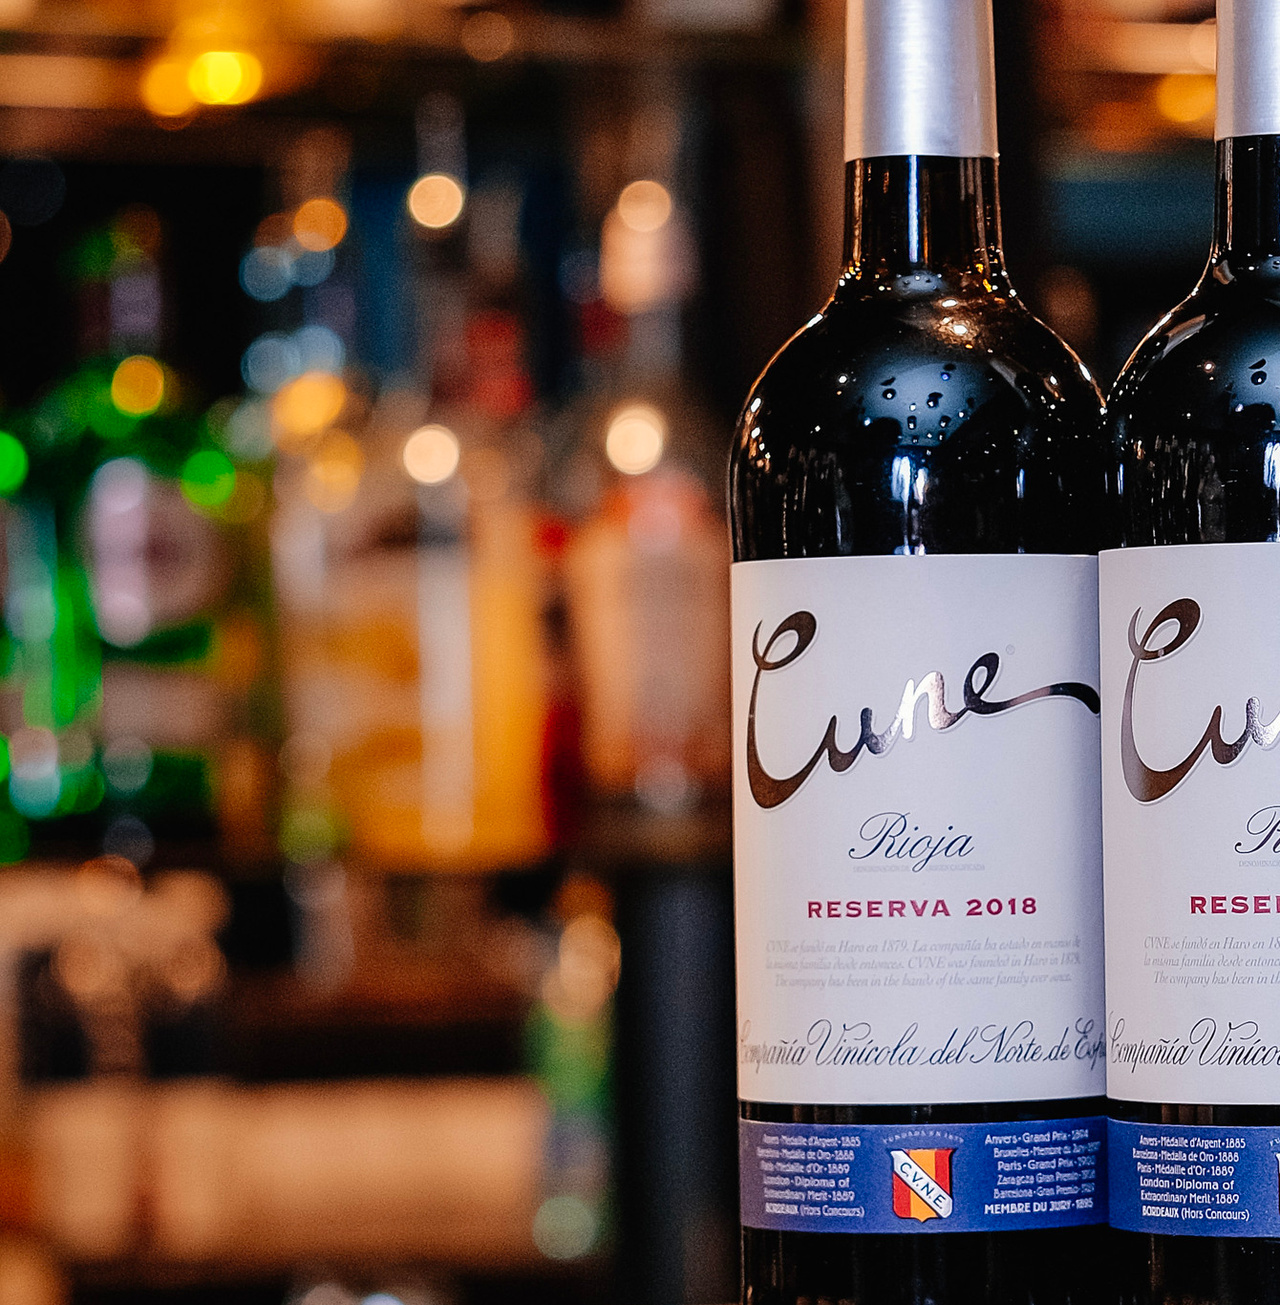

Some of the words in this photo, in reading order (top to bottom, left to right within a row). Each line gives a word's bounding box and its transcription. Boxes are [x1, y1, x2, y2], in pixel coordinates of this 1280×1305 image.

[747, 610, 1101, 809] Cune
[848, 811, 975, 873] Rioja
[807, 899, 951, 919] RESERVA
[966, 897, 1037, 917] 2018
[1223, 936, 1250, 949] Haro
[1232, 971, 1254, 984] been
[1257, 972, 1267, 984] in
[806, 1018, 925, 1066] Vinícola
[920, 1027, 975, 1065] del
[971, 1020, 1044, 1063] Norte
[1044, 1027, 1070, 1061] de
[1110, 1011, 1193, 1073] Compañía
[1226, 1138, 1246, 1149] 1885
[1212, 1166, 1234, 1177] 1889
[1176, 1179, 1219, 1191] Diploma
[1223, 1180, 1234, 1191] of
[1216, 1194, 1239, 1205] 1889
[1142, 1206, 1179, 1219] BORDEAUX
[1182, 1209, 1203, 1221] (Hors
[1205, 1209, 1250, 1222] Concours)
